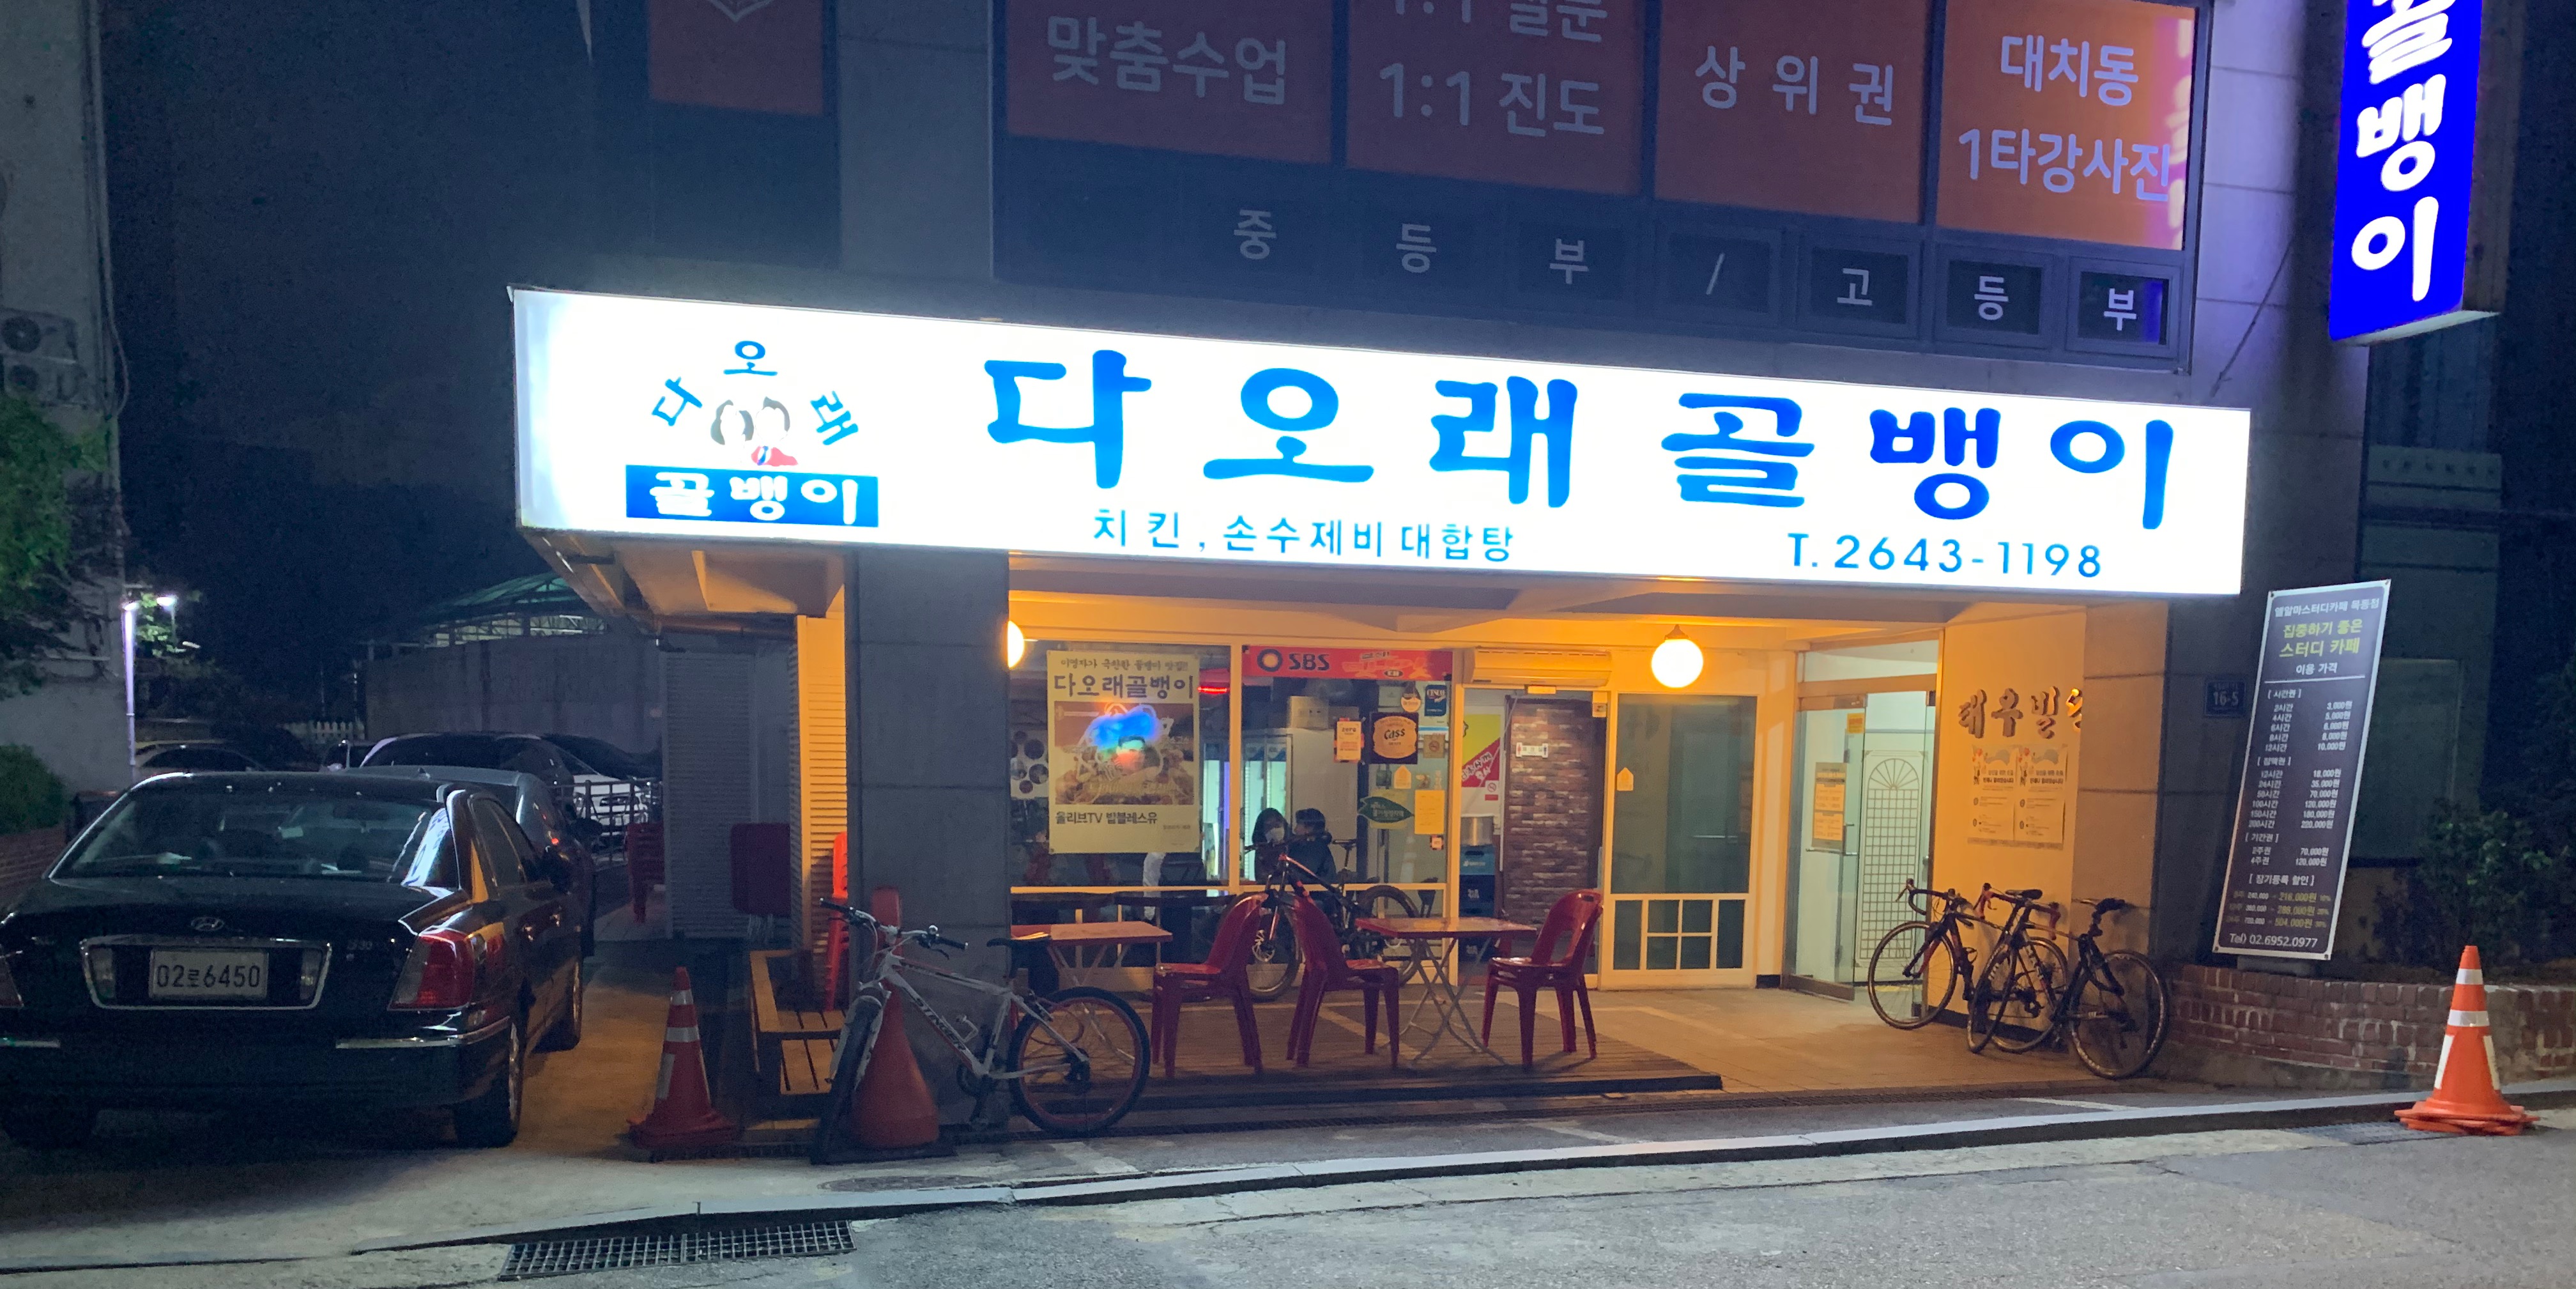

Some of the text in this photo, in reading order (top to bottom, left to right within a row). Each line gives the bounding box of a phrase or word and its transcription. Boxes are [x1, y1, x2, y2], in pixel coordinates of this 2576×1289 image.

[1046, 16, 1285, 104] 맞춤수업
[2000, 35, 2138, 105] 대치동
[1380, 63, 1604, 137] 1:1 진도
[1959, 128, 2170, 201] 1타강사진
[985, 350, 2174, 530] 다오래 골뱅이
[650, 471, 857, 525] 골뱅이
[1223, 514, 1383, 558] 손수제비
[1402, 523, 1514, 562] 대합탕
[1834, 534, 2101, 578] 2643-1198
[2279, 637, 2360, 658] 스터디 카페
[2283, 622, 2333, 638] 집중하기
[1289, 653, 1330, 670] SBS
[2296, 662, 2338, 675] 이용 가격
[1054, 673, 1193, 699] 다오래골뱅이
[1384, 729, 1406, 740] Cass
